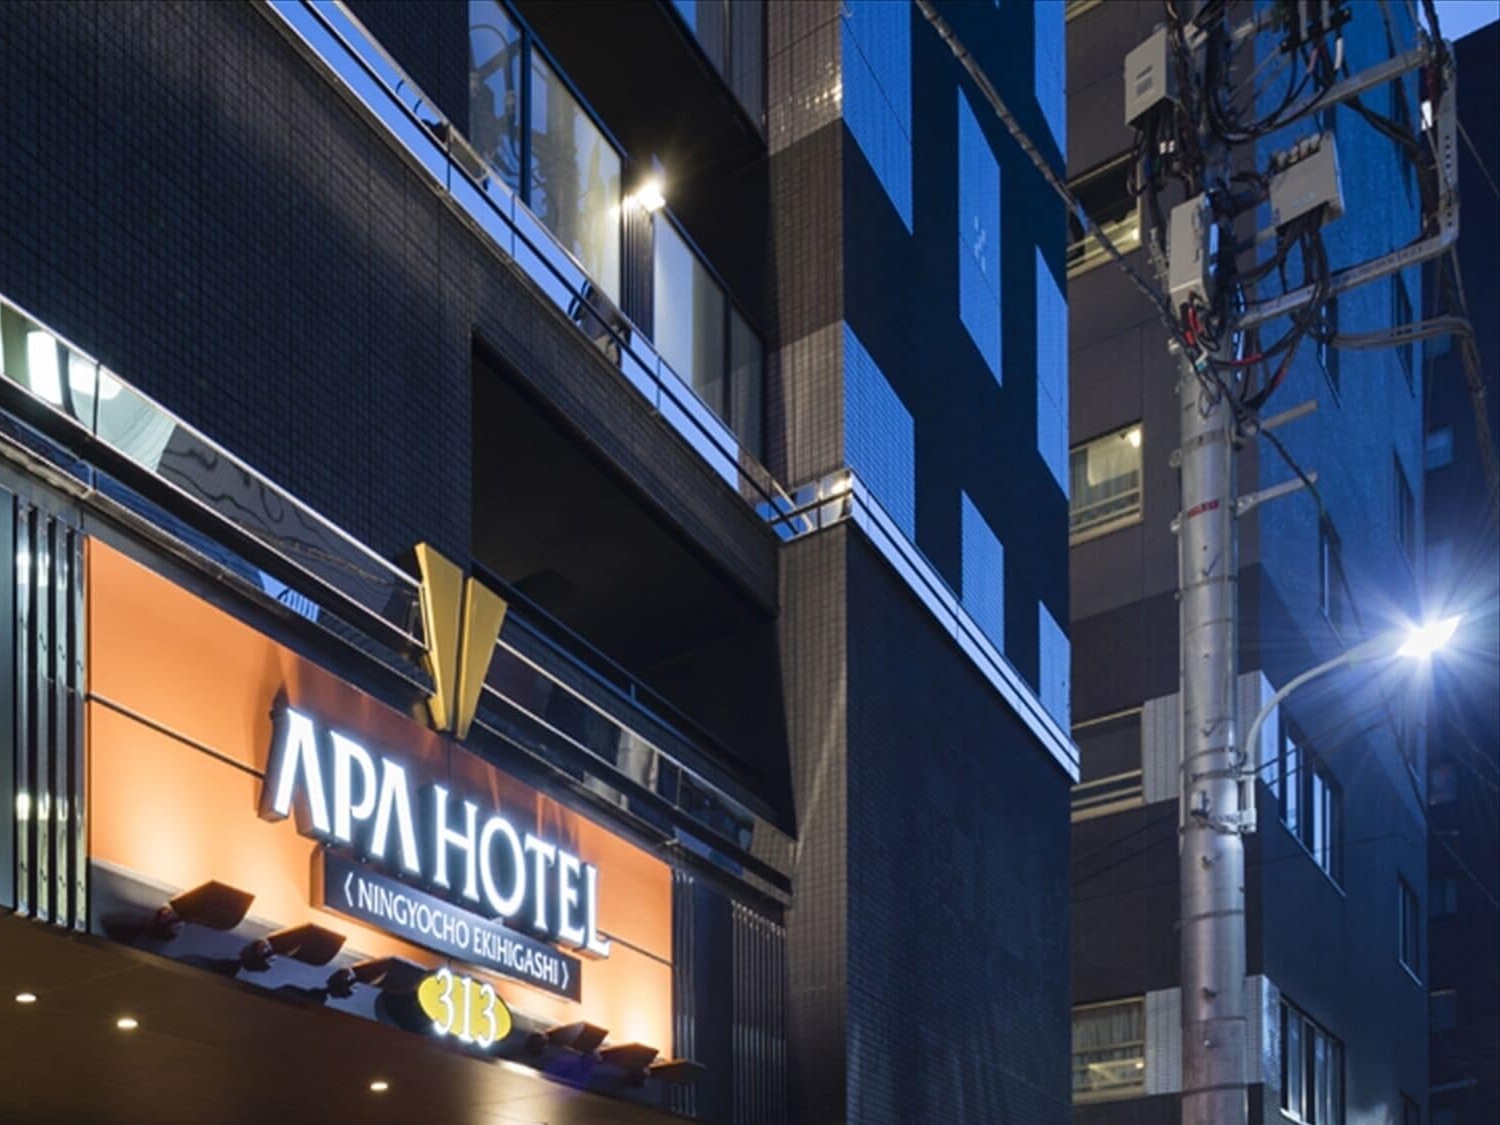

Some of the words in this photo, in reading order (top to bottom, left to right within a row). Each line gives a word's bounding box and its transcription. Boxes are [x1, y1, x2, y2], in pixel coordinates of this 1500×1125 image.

[273, 707, 419, 877] APA
[433, 783, 612, 952] HOTEL
[432, 967, 499, 1049] 313
